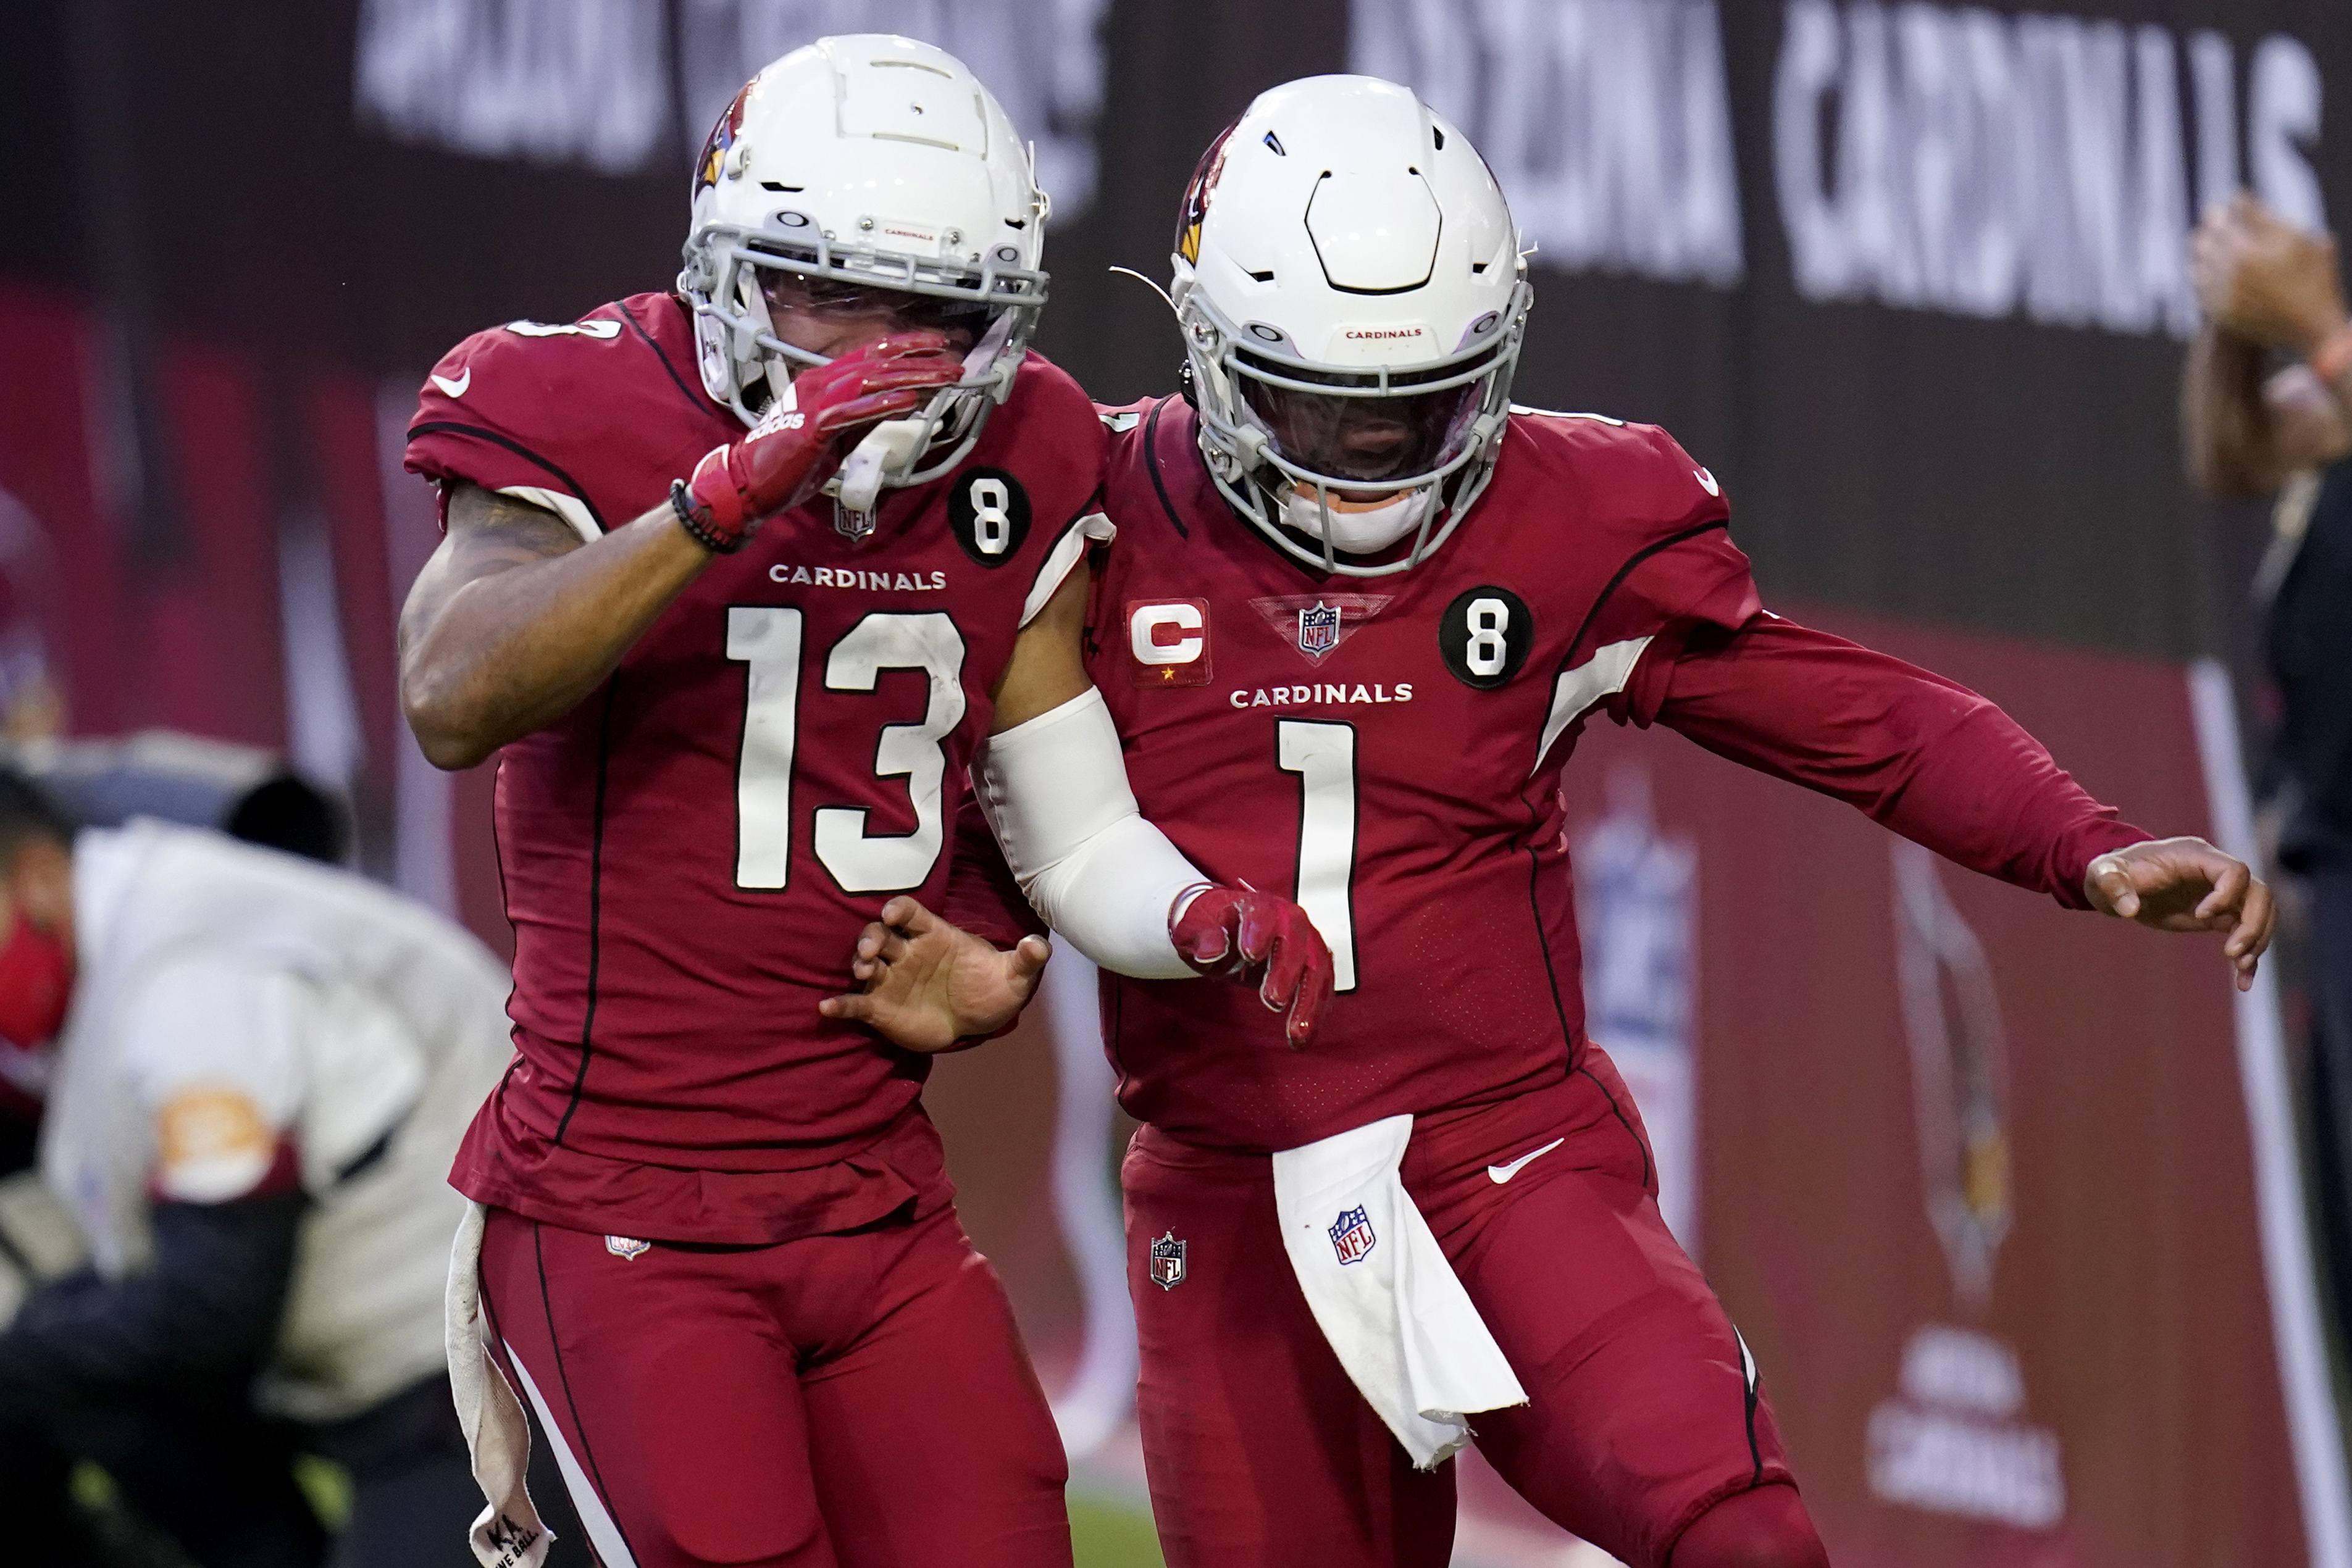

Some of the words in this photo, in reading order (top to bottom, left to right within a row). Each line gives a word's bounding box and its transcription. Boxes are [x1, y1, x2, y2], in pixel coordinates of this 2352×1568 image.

[1345, 328, 1422, 340] CARDINALS
[745, 413, 805, 444] adidas
[969, 478, 1010, 554] 8
[769, 563, 947, 591] CARDINALS
[1131, 603, 1203, 665] C
[1305, 627, 1332, 647] NFL
[1467, 598, 1509, 676] 8
[1229, 683, 1413, 709] CARDINALS
[724, 605, 968, 895] 13
[1276, 719, 1357, 993] 1
[1337, 1225, 1371, 1261] NFL
[1155, 1259, 1179, 1280] NFL
[495, 1554, 514, 1568] NE
